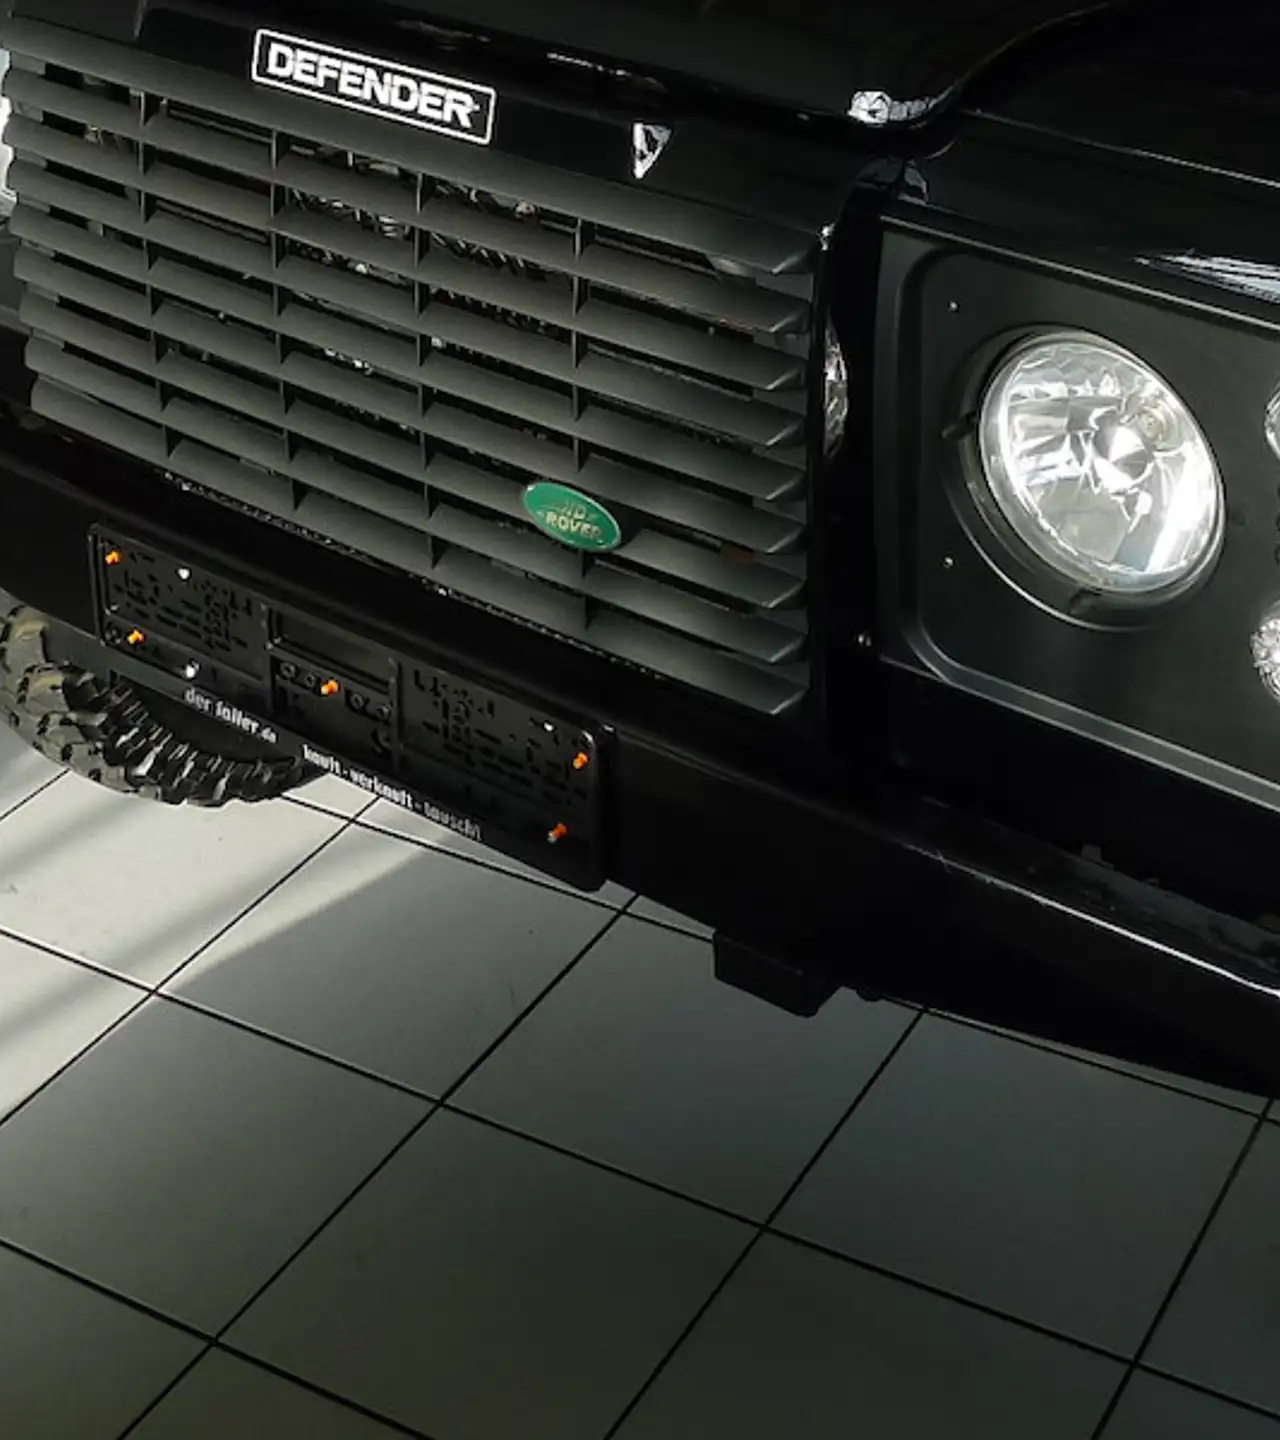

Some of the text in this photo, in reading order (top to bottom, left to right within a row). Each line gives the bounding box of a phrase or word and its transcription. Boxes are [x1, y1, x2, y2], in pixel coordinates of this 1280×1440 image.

[266, 42, 480, 129] DEFENDER
[545, 511, 602, 541] ROVER
[185, 687, 212, 712] der
